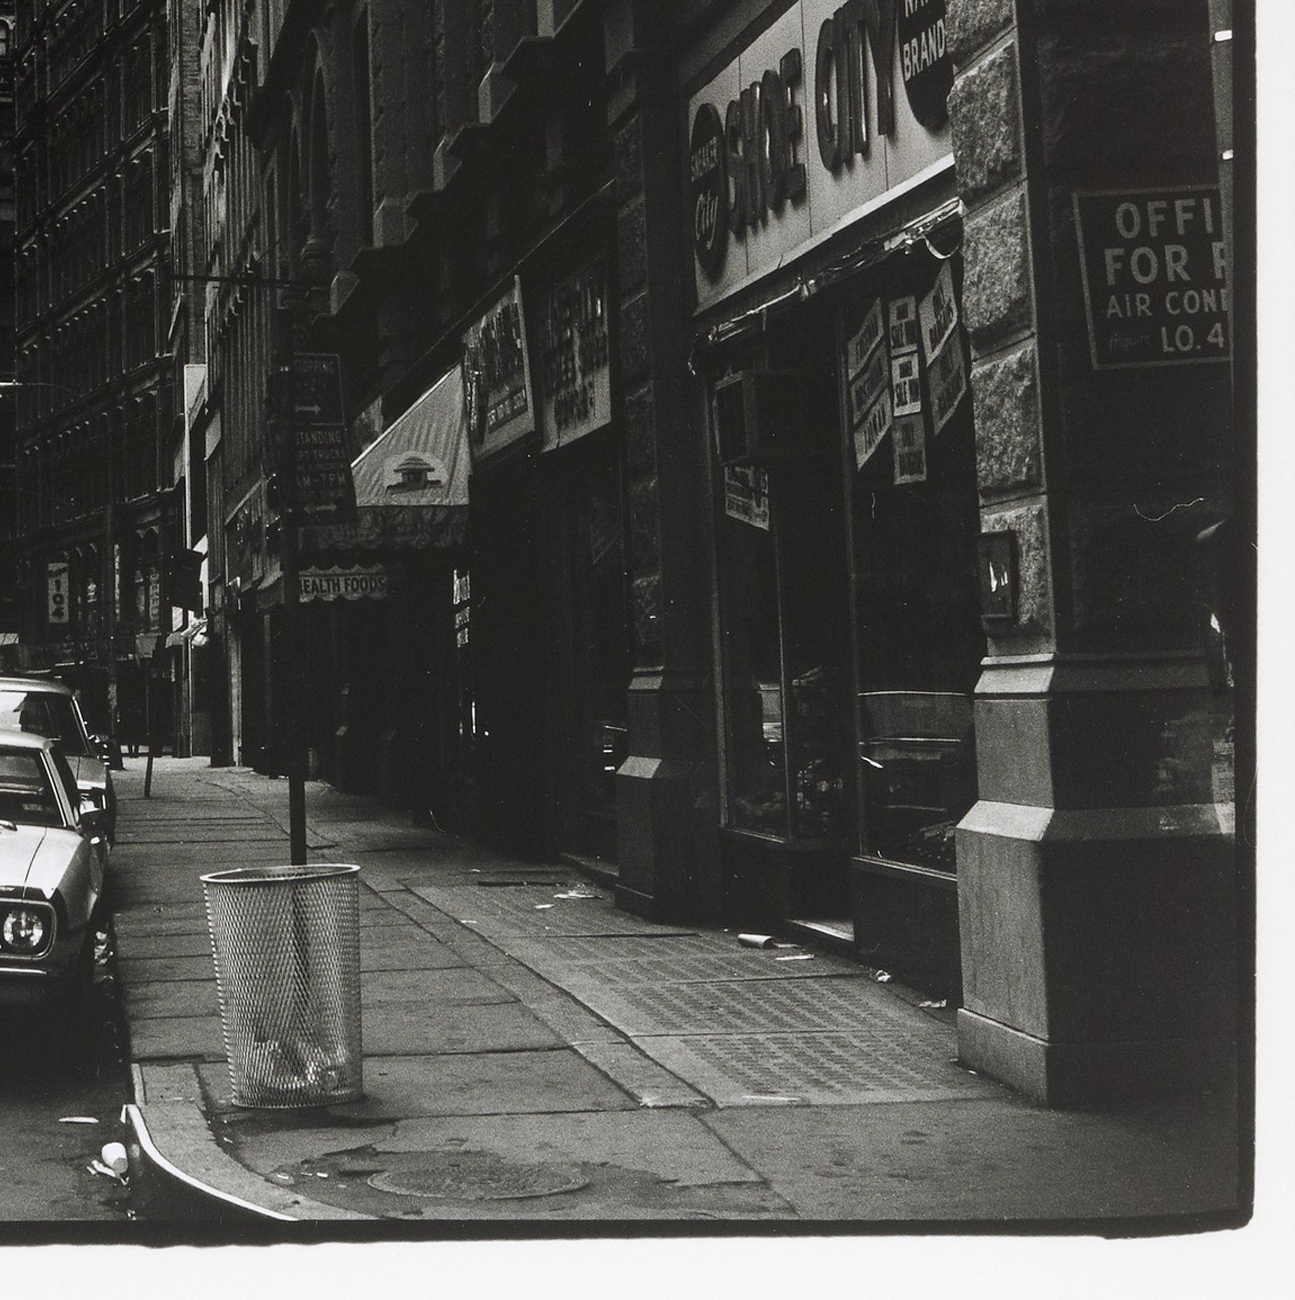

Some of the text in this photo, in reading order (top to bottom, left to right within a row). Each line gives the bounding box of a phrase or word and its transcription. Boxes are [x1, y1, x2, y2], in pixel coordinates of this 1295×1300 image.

[903, 18, 946, 81] BRAND
[725, 47, 806, 240] SHOE
[694, 189, 719, 250] City
[1115, 198, 1214, 239] OFFI
[1104, 244, 1192, 286] FOR
[1106, 293, 1153, 319] AIR
[1161, 324, 1202, 353] LO.
[1207, 322, 1225, 349] 4
[344, 576, 385, 592] FOODS
